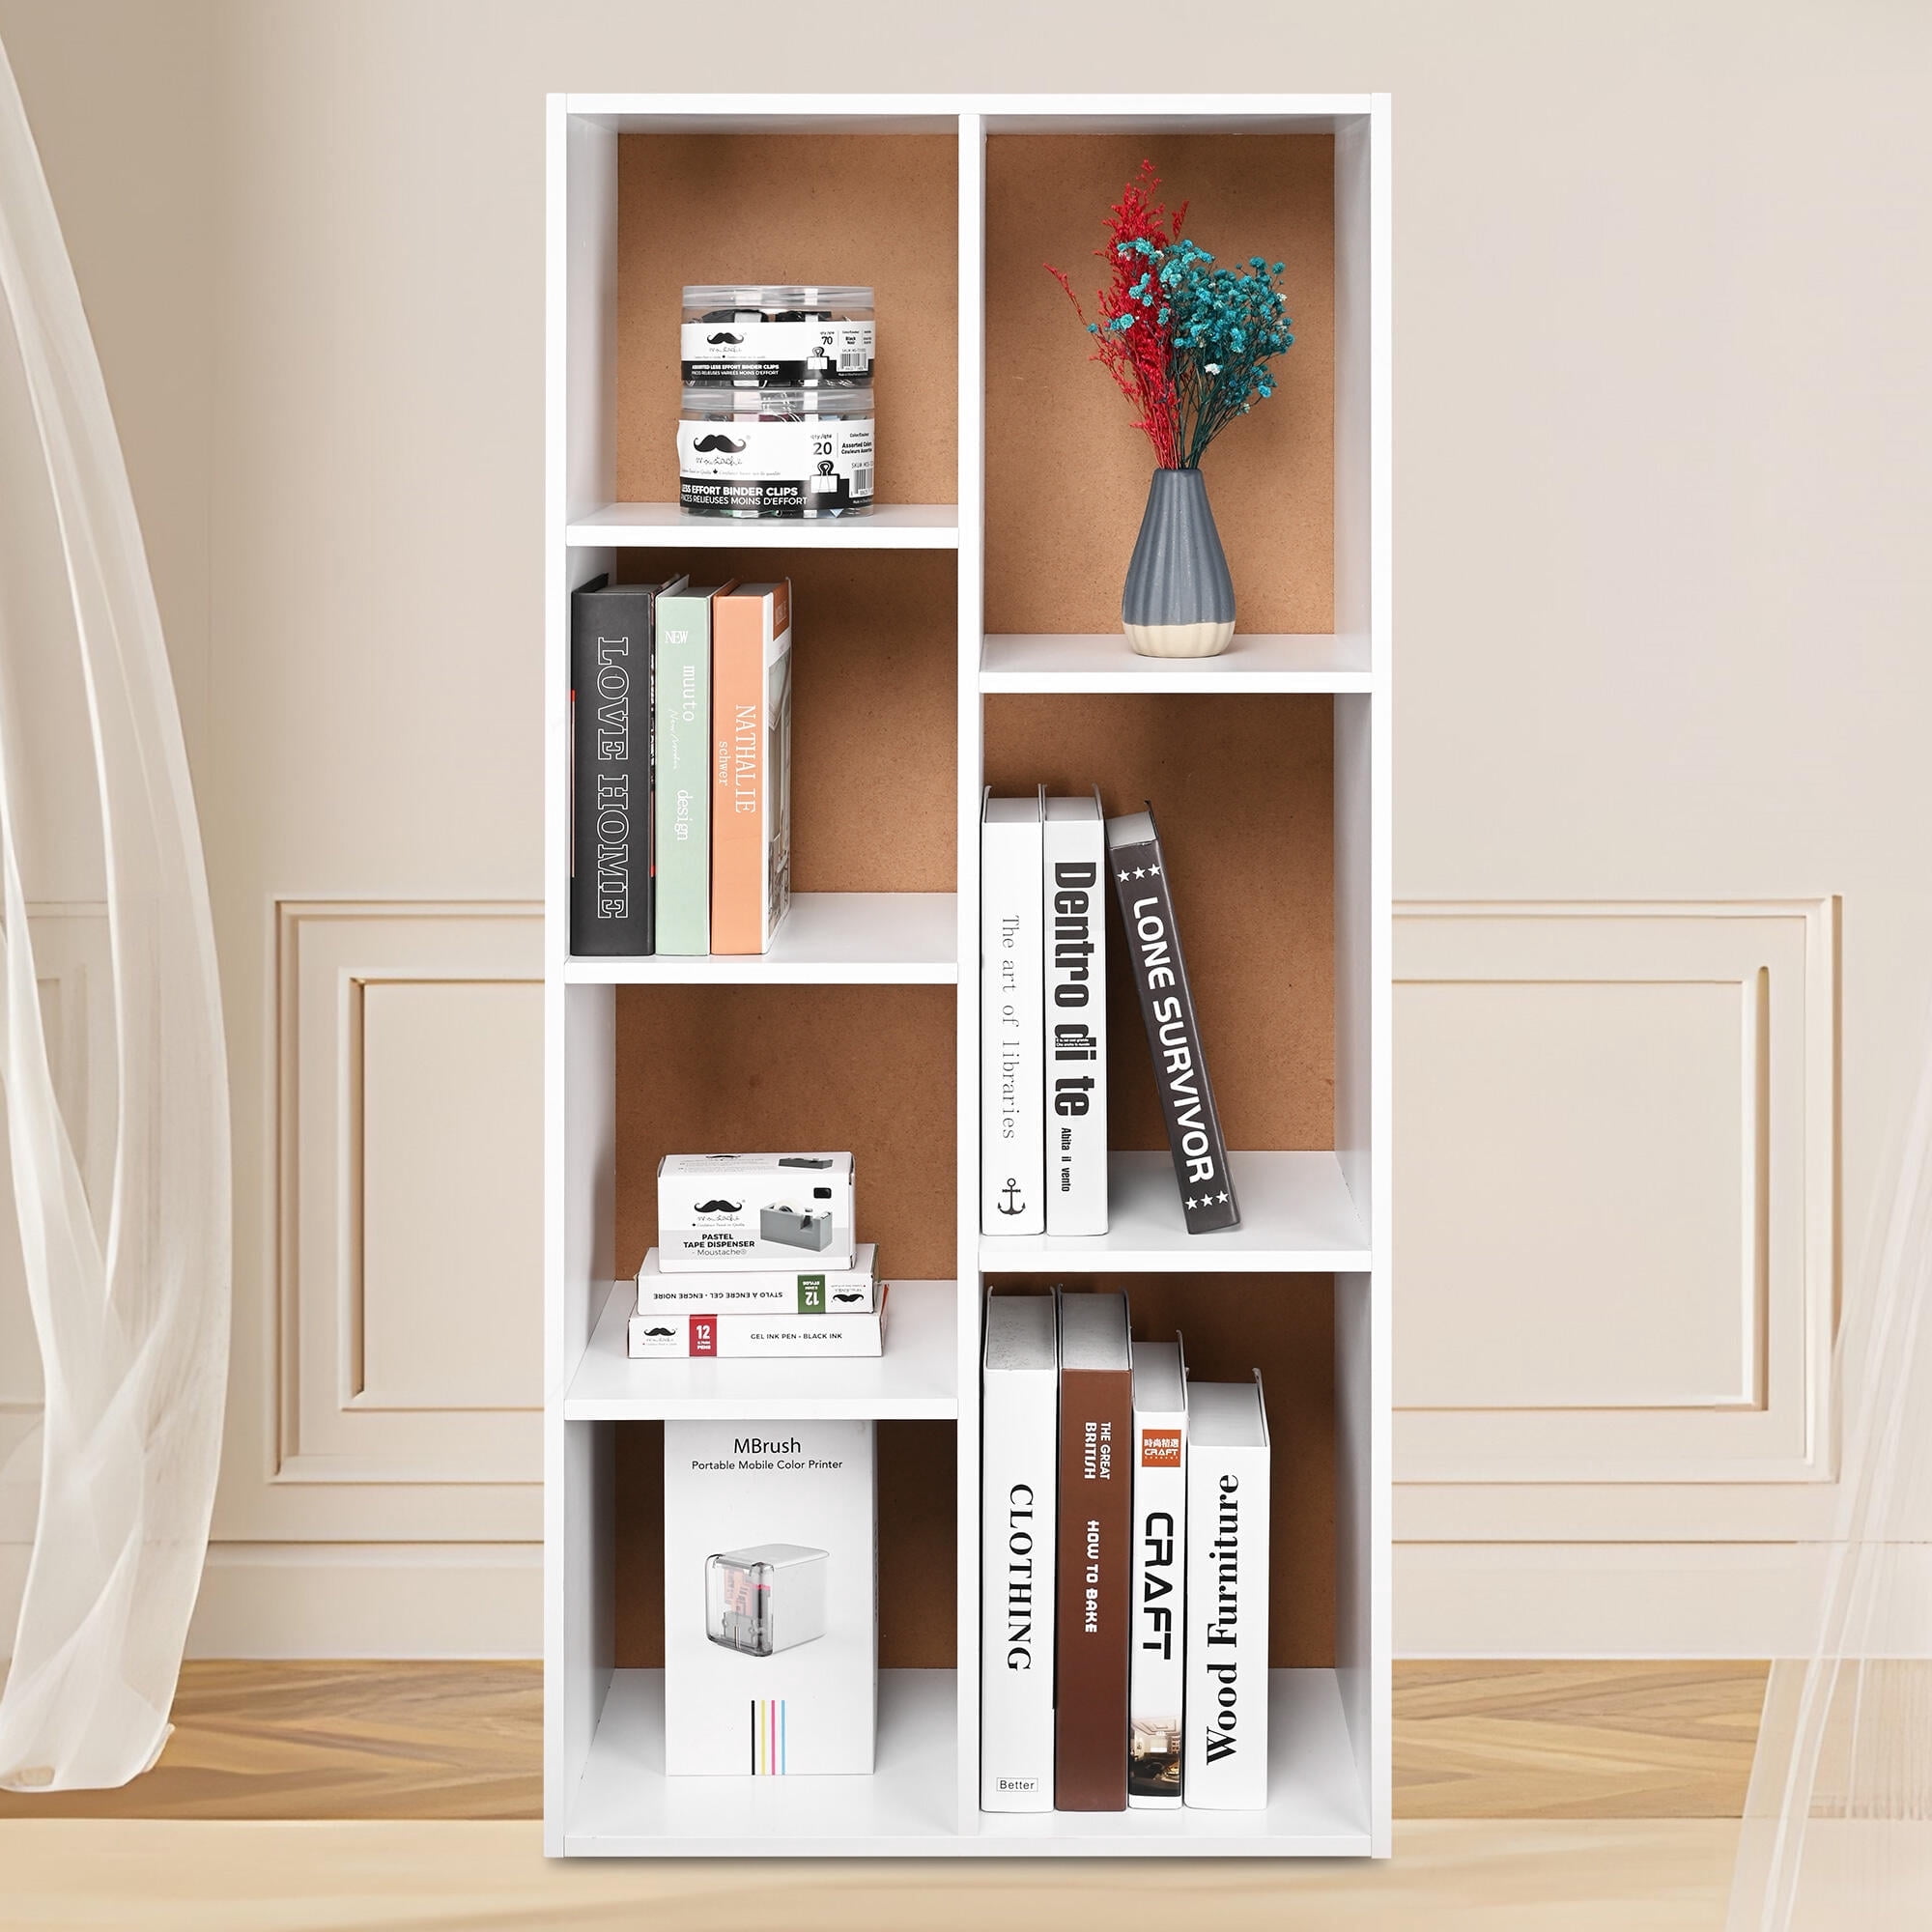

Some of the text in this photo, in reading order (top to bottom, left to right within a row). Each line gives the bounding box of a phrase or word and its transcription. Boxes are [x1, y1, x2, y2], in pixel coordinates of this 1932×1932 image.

[821, 336, 833, 345] 70
[813, 441, 832, 455] 20
[692, 485, 721, 496] EFFORT
[723, 486, 763, 497] BINDER
[766, 487, 798, 497] CLIPS
[693, 495, 728, 505] RELIEUSES
[730, 497, 760, 505] MOINS
[763, 497, 808, 505] D'EFFORT
[665, 631, 688, 644] NEW
[683, 666, 697, 722] muuto
[597, 637, 630, 919] LOVE HOME
[718, 741, 728, 786] schwer
[735, 704, 756, 814] NATHALIE
[675, 789, 694, 840] design
[1054, 862, 1096, 1009] Dentro
[1002, 914, 1020, 1139] The art of libraries
[1054, 1024, 1096, 1061] di
[1132, 896, 1215, 1183] LONE SURVIVOR
[1054, 1076, 1095, 1117] te
[1061, 1127, 1071, 1151] Abita
[1061, 1168, 1070, 1192] vento
[806, 1293, 819, 1306] 12
[696, 1324, 710, 1339] 12
[692, 1460, 843, 1470] Portable Mobile Color Printer
[733, 1437, 802, 1455] MBrush
[1085, 1422, 1097, 1479] BRITISH
[1099, 1422, 1112, 1480] THE GREAT
[1008, 1484, 1034, 1671] CLOTHING
[1086, 1520, 1099, 1634] HOW TO BAKE
[1143, 1512, 1174, 1661] CRAFT
[1207, 1474, 1239, 1766] Wood Furniture
[999, 1779, 1035, 1791] Better
